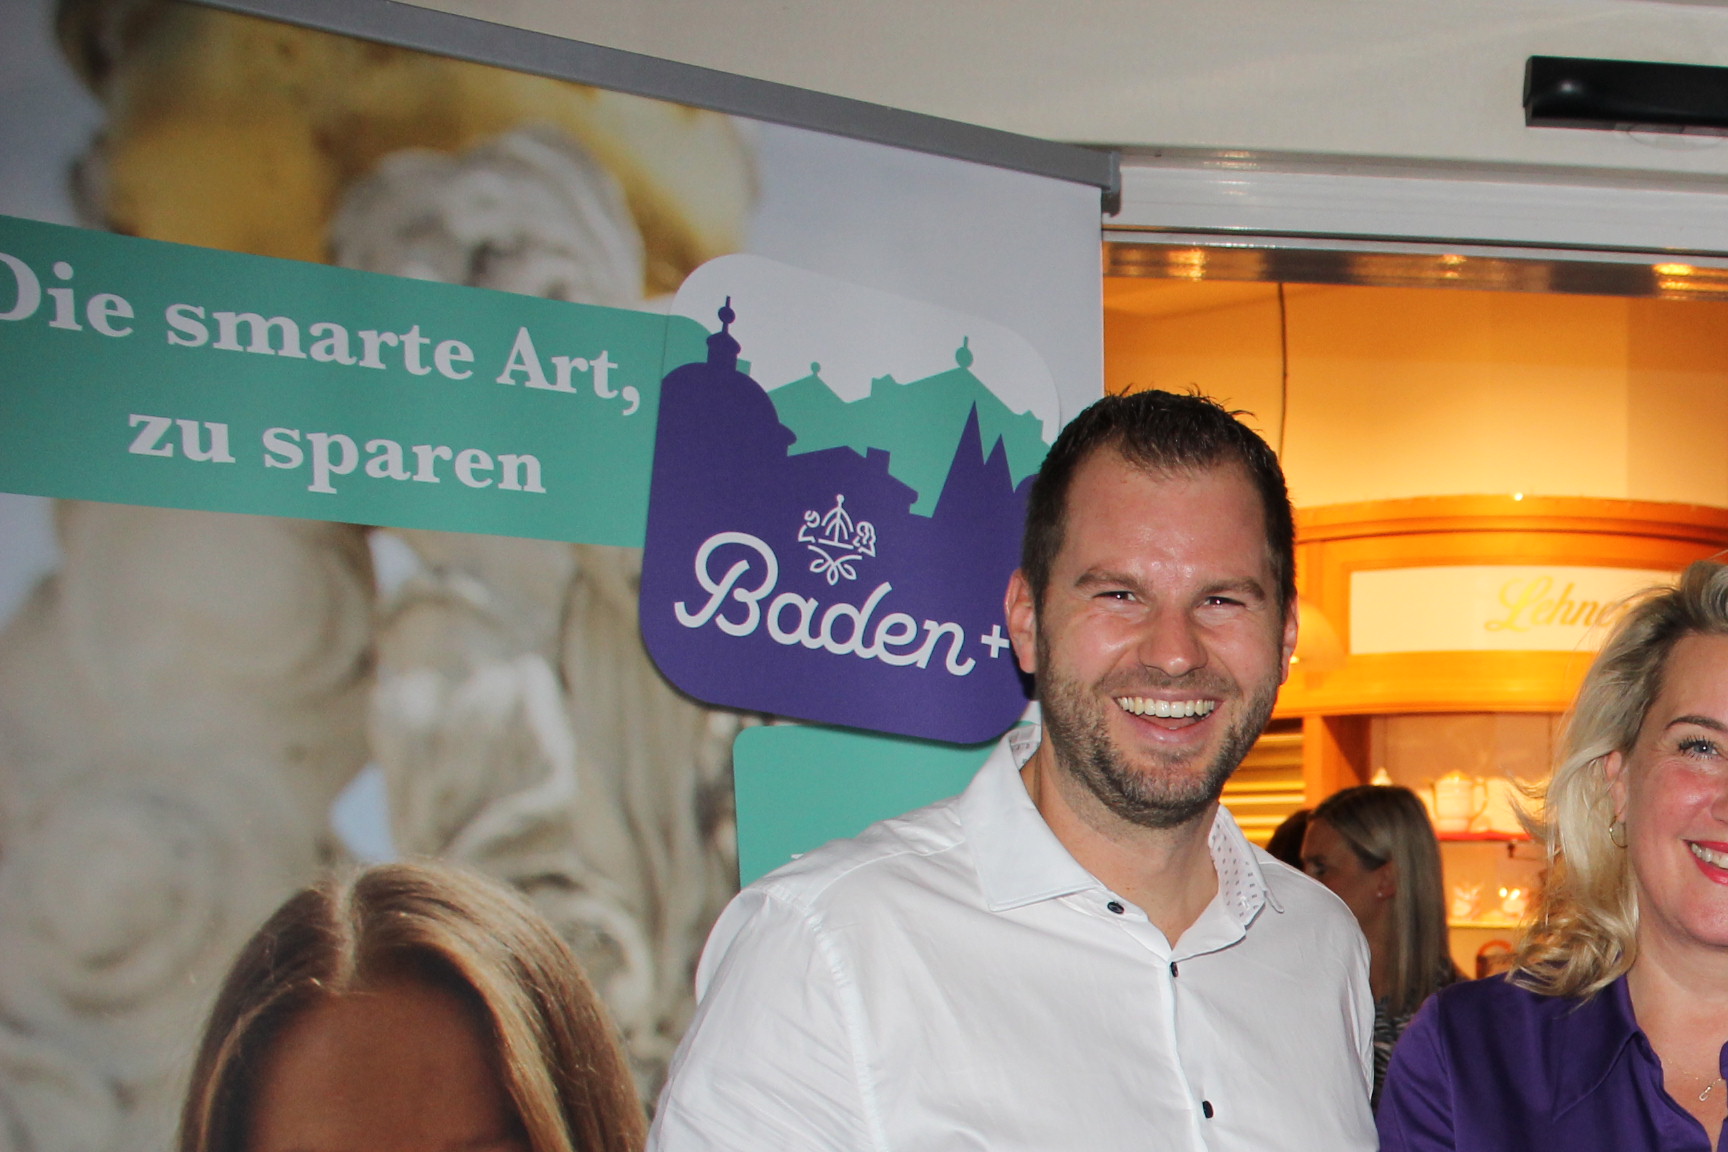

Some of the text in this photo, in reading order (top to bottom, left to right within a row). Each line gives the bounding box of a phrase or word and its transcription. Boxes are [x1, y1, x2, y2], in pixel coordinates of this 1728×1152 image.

[0, 252, 641, 417] Die smarte Art,
[128, 413, 547, 495] zu sparen
[1484, 575, 1630, 632] Lehne
